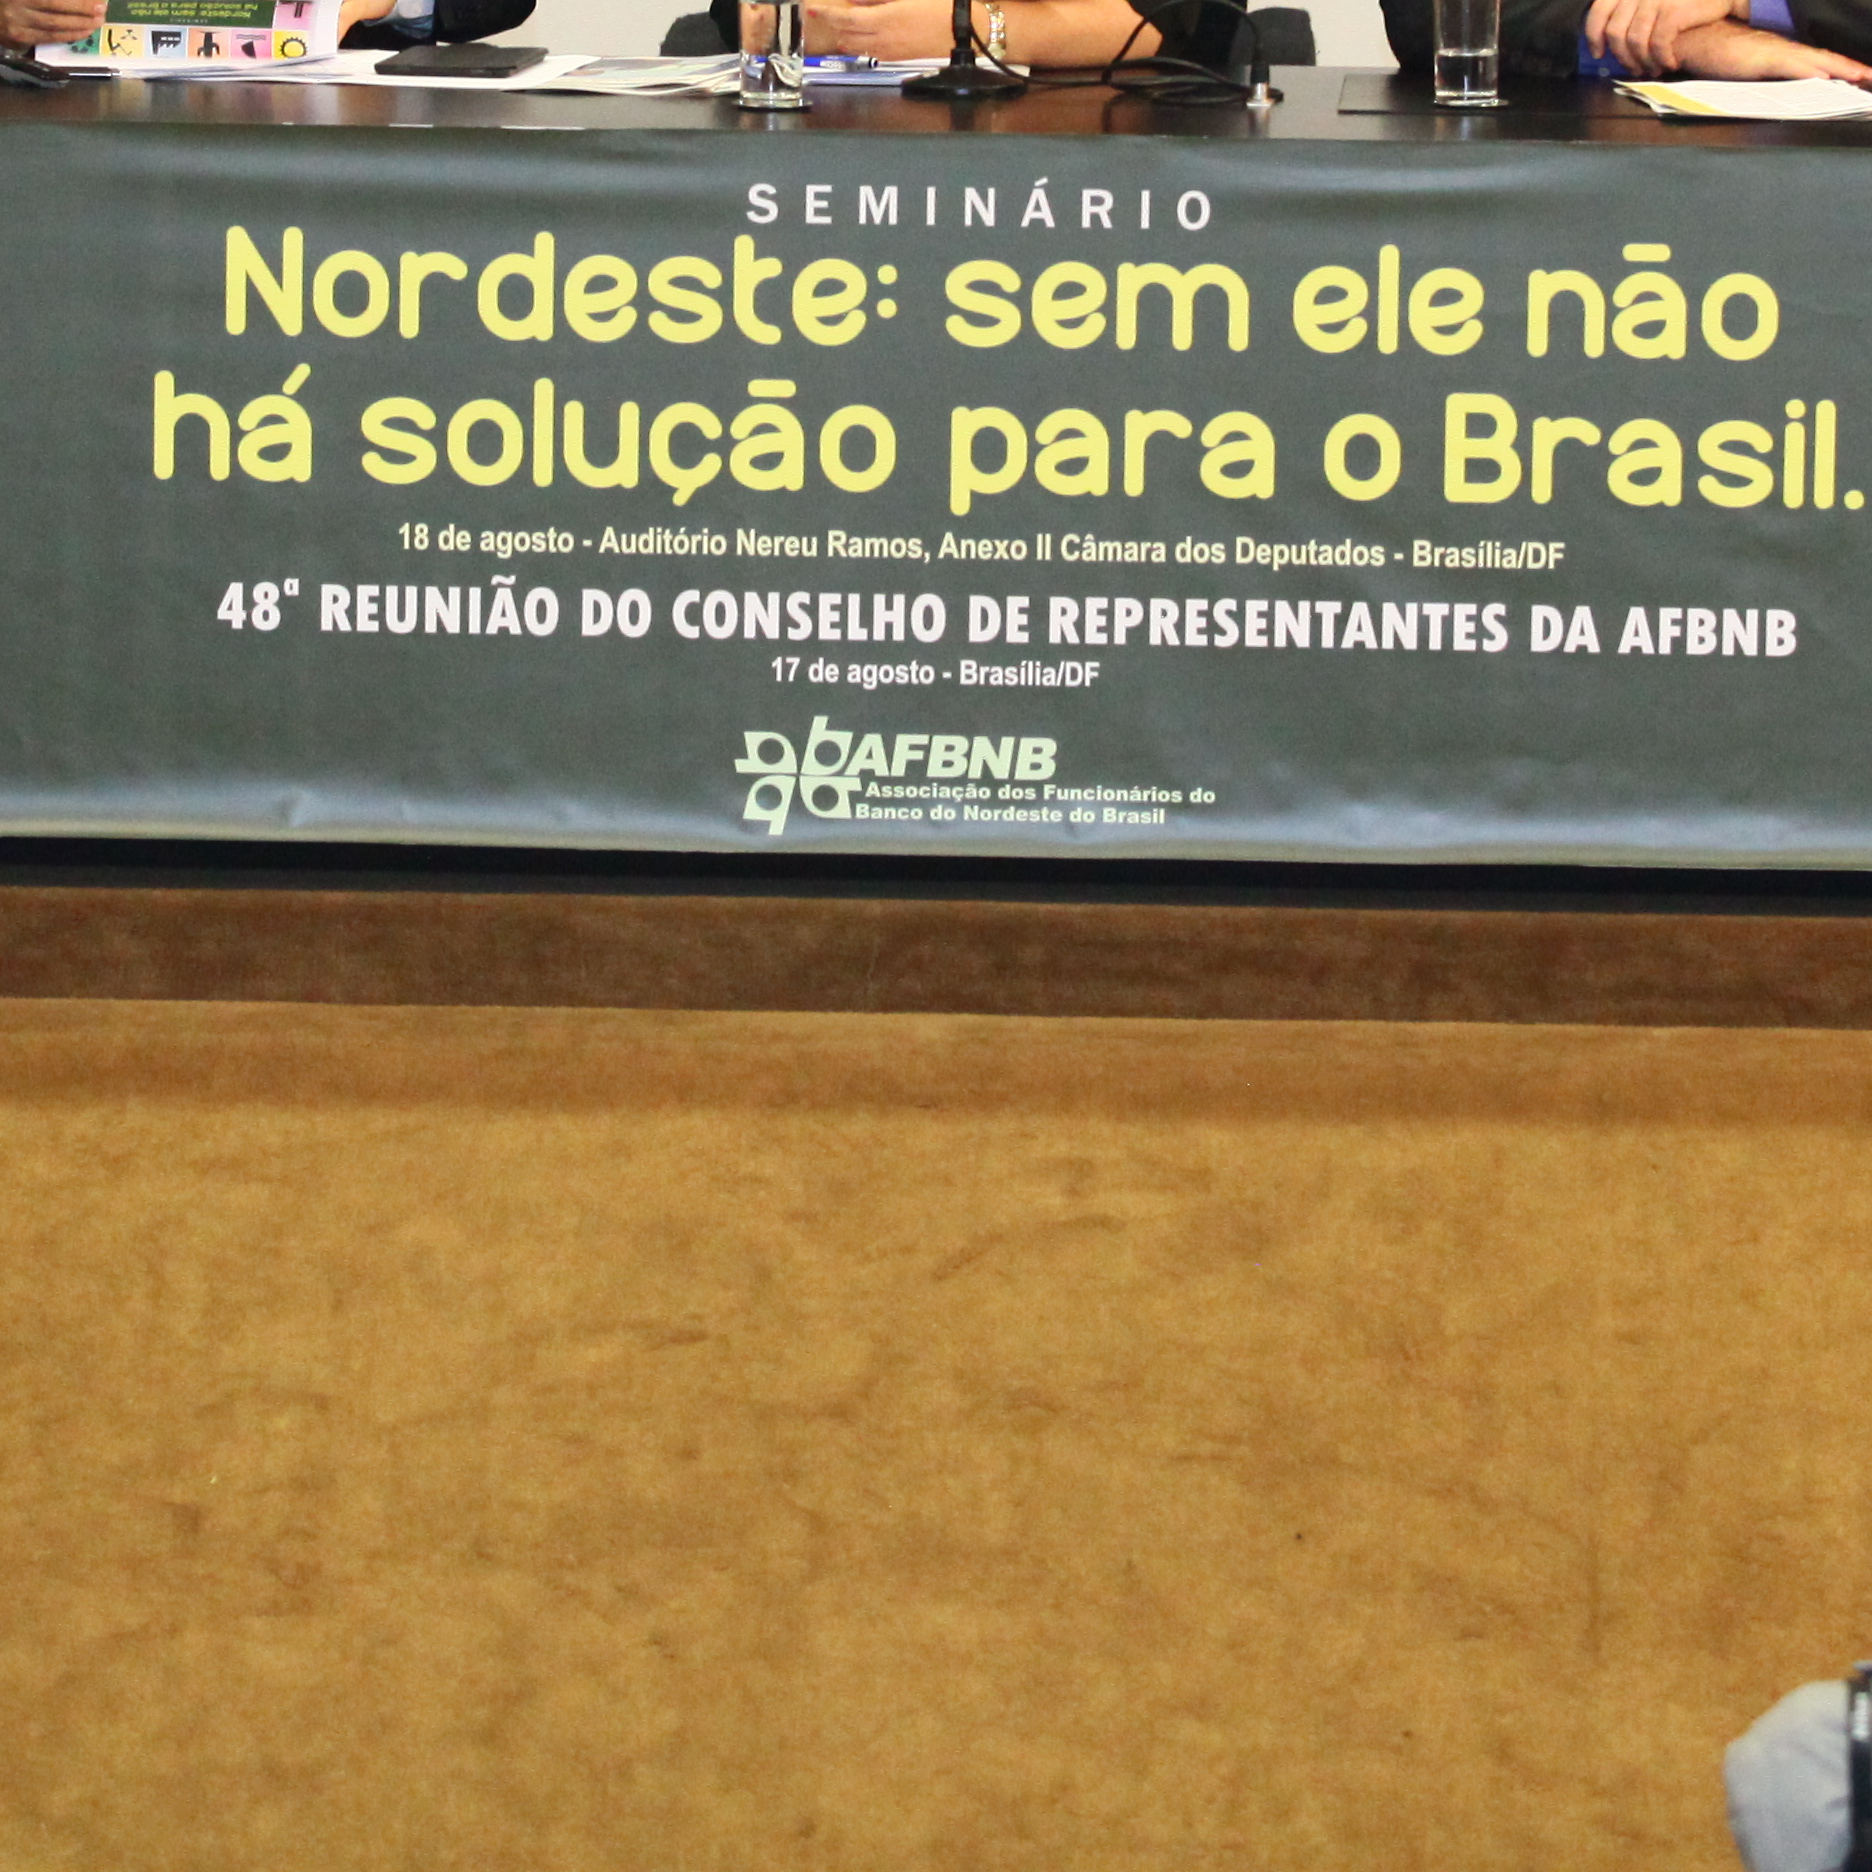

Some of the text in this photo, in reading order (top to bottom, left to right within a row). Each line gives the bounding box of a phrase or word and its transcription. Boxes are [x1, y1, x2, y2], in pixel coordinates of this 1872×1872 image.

[746, 178, 1211, 231] SEMINÁRIO
[225, 225, 1779, 361] Nordeste: sem ele não
[153, 364, 1865, 517] há solução para o Brasil.
[398, 522, 1566, 571] 18 de agosto - Auditório Nereu Ramos, Anexo II Câmara dos Deputados - Brasília/DF
[217, 575, 1797, 657] 48ª REUNIÃO DO CONSELHO DE REPRESENTANTES DA AFBNB
[771, 656, 1101, 689] 17 de agosto - Brasília/DF
[844, 732, 1058, 780] AFBNB
[855, 803, 1165, 825] Banco do Nordeste do Brasil
[865, 781, 1216, 804] Associação dos Funcionários do
